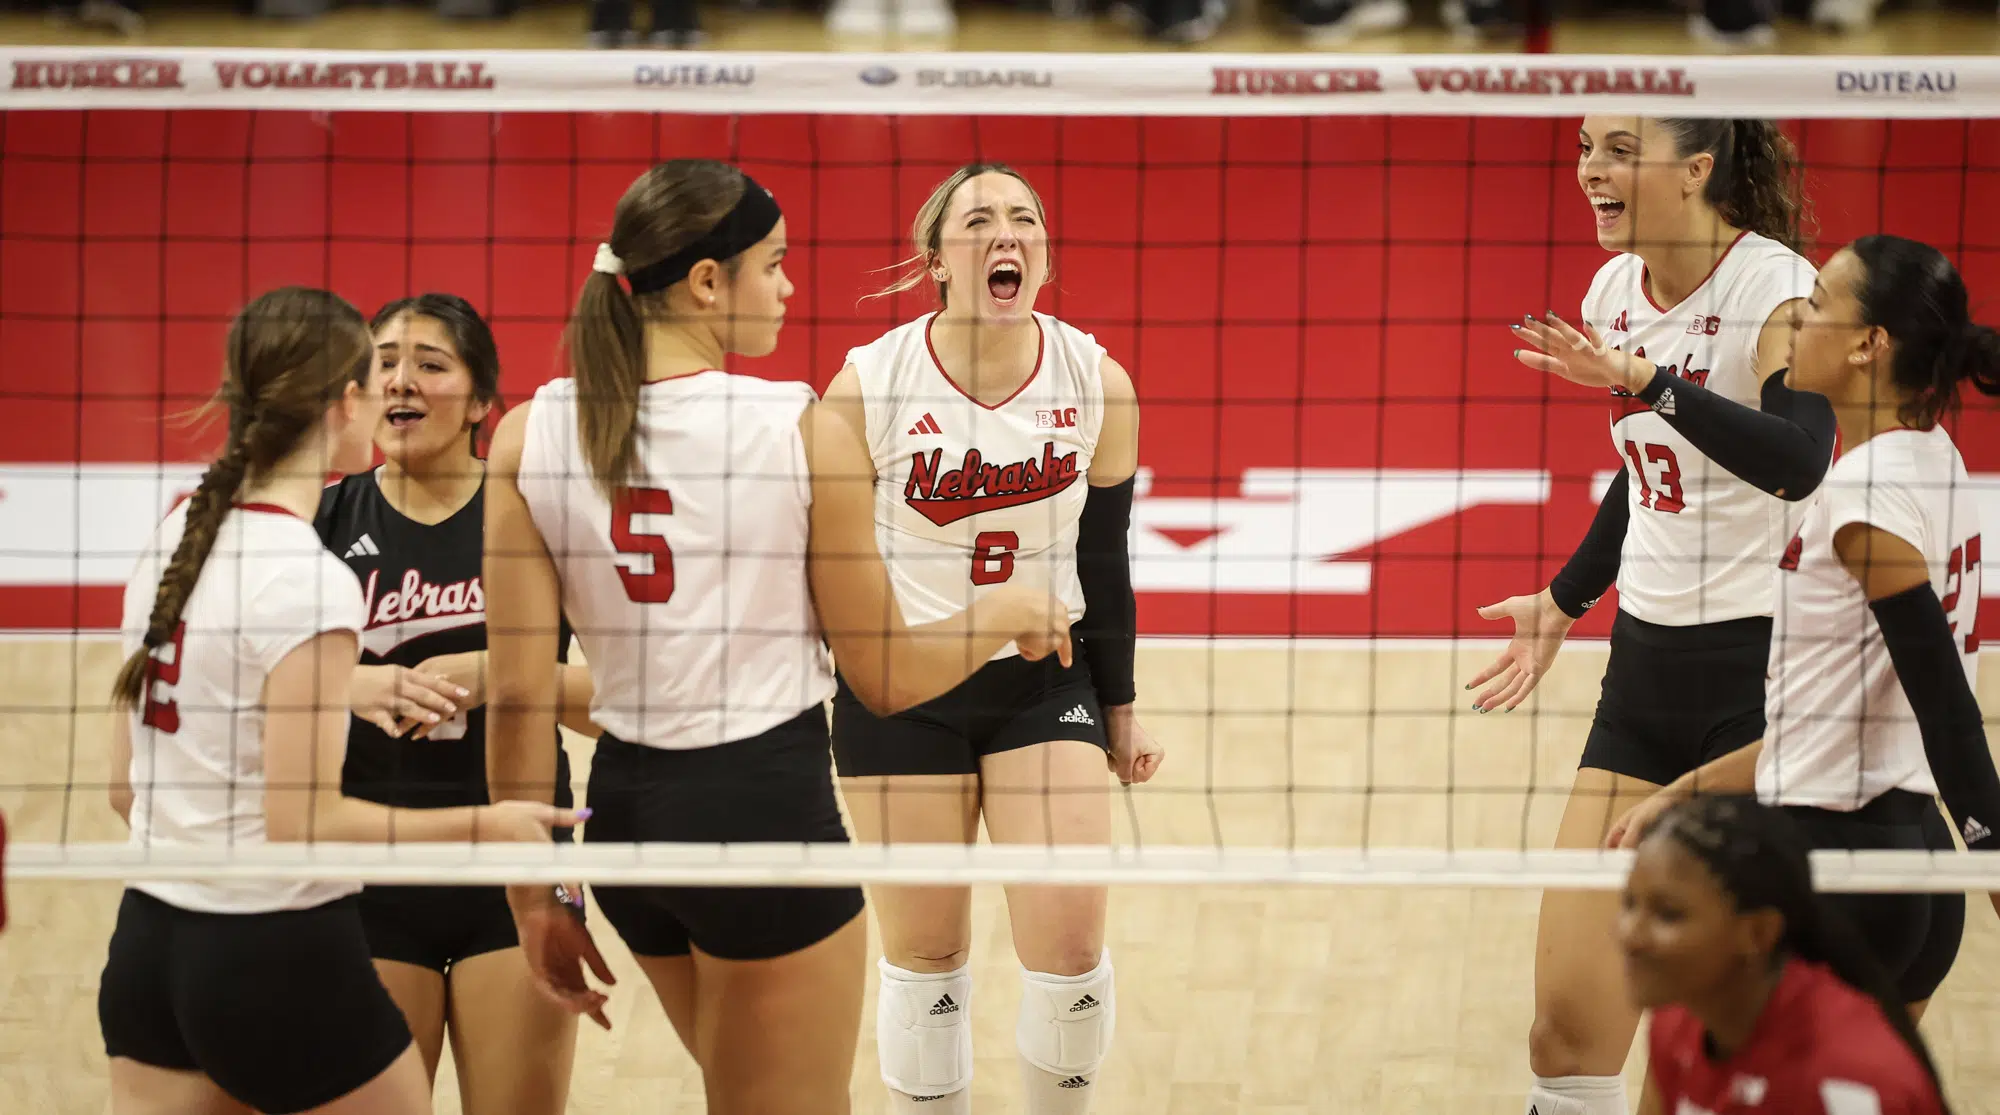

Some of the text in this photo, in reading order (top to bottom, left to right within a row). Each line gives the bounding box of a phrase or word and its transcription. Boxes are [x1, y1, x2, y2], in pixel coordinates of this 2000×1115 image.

[12, 60, 495, 89] HUSKER VOLLEYBALL
[634, 65, 756, 86] DUTEAU
[916, 70, 1052, 88] SUBARU
[1212, 67, 1695, 96] HUSKER VOLLEYBALL
[1836, 70, 1957, 93] DUTEAU
[904, 441, 1081, 500] Nebraska
[1625, 440, 1686, 514] 13
[610, 486, 675, 604] 5
[970, 531, 1019, 586] 6
[364, 568, 485, 632] ebras
[929, 1003, 959, 1016] adidas
[1069, 1000, 1100, 1013] adidas
